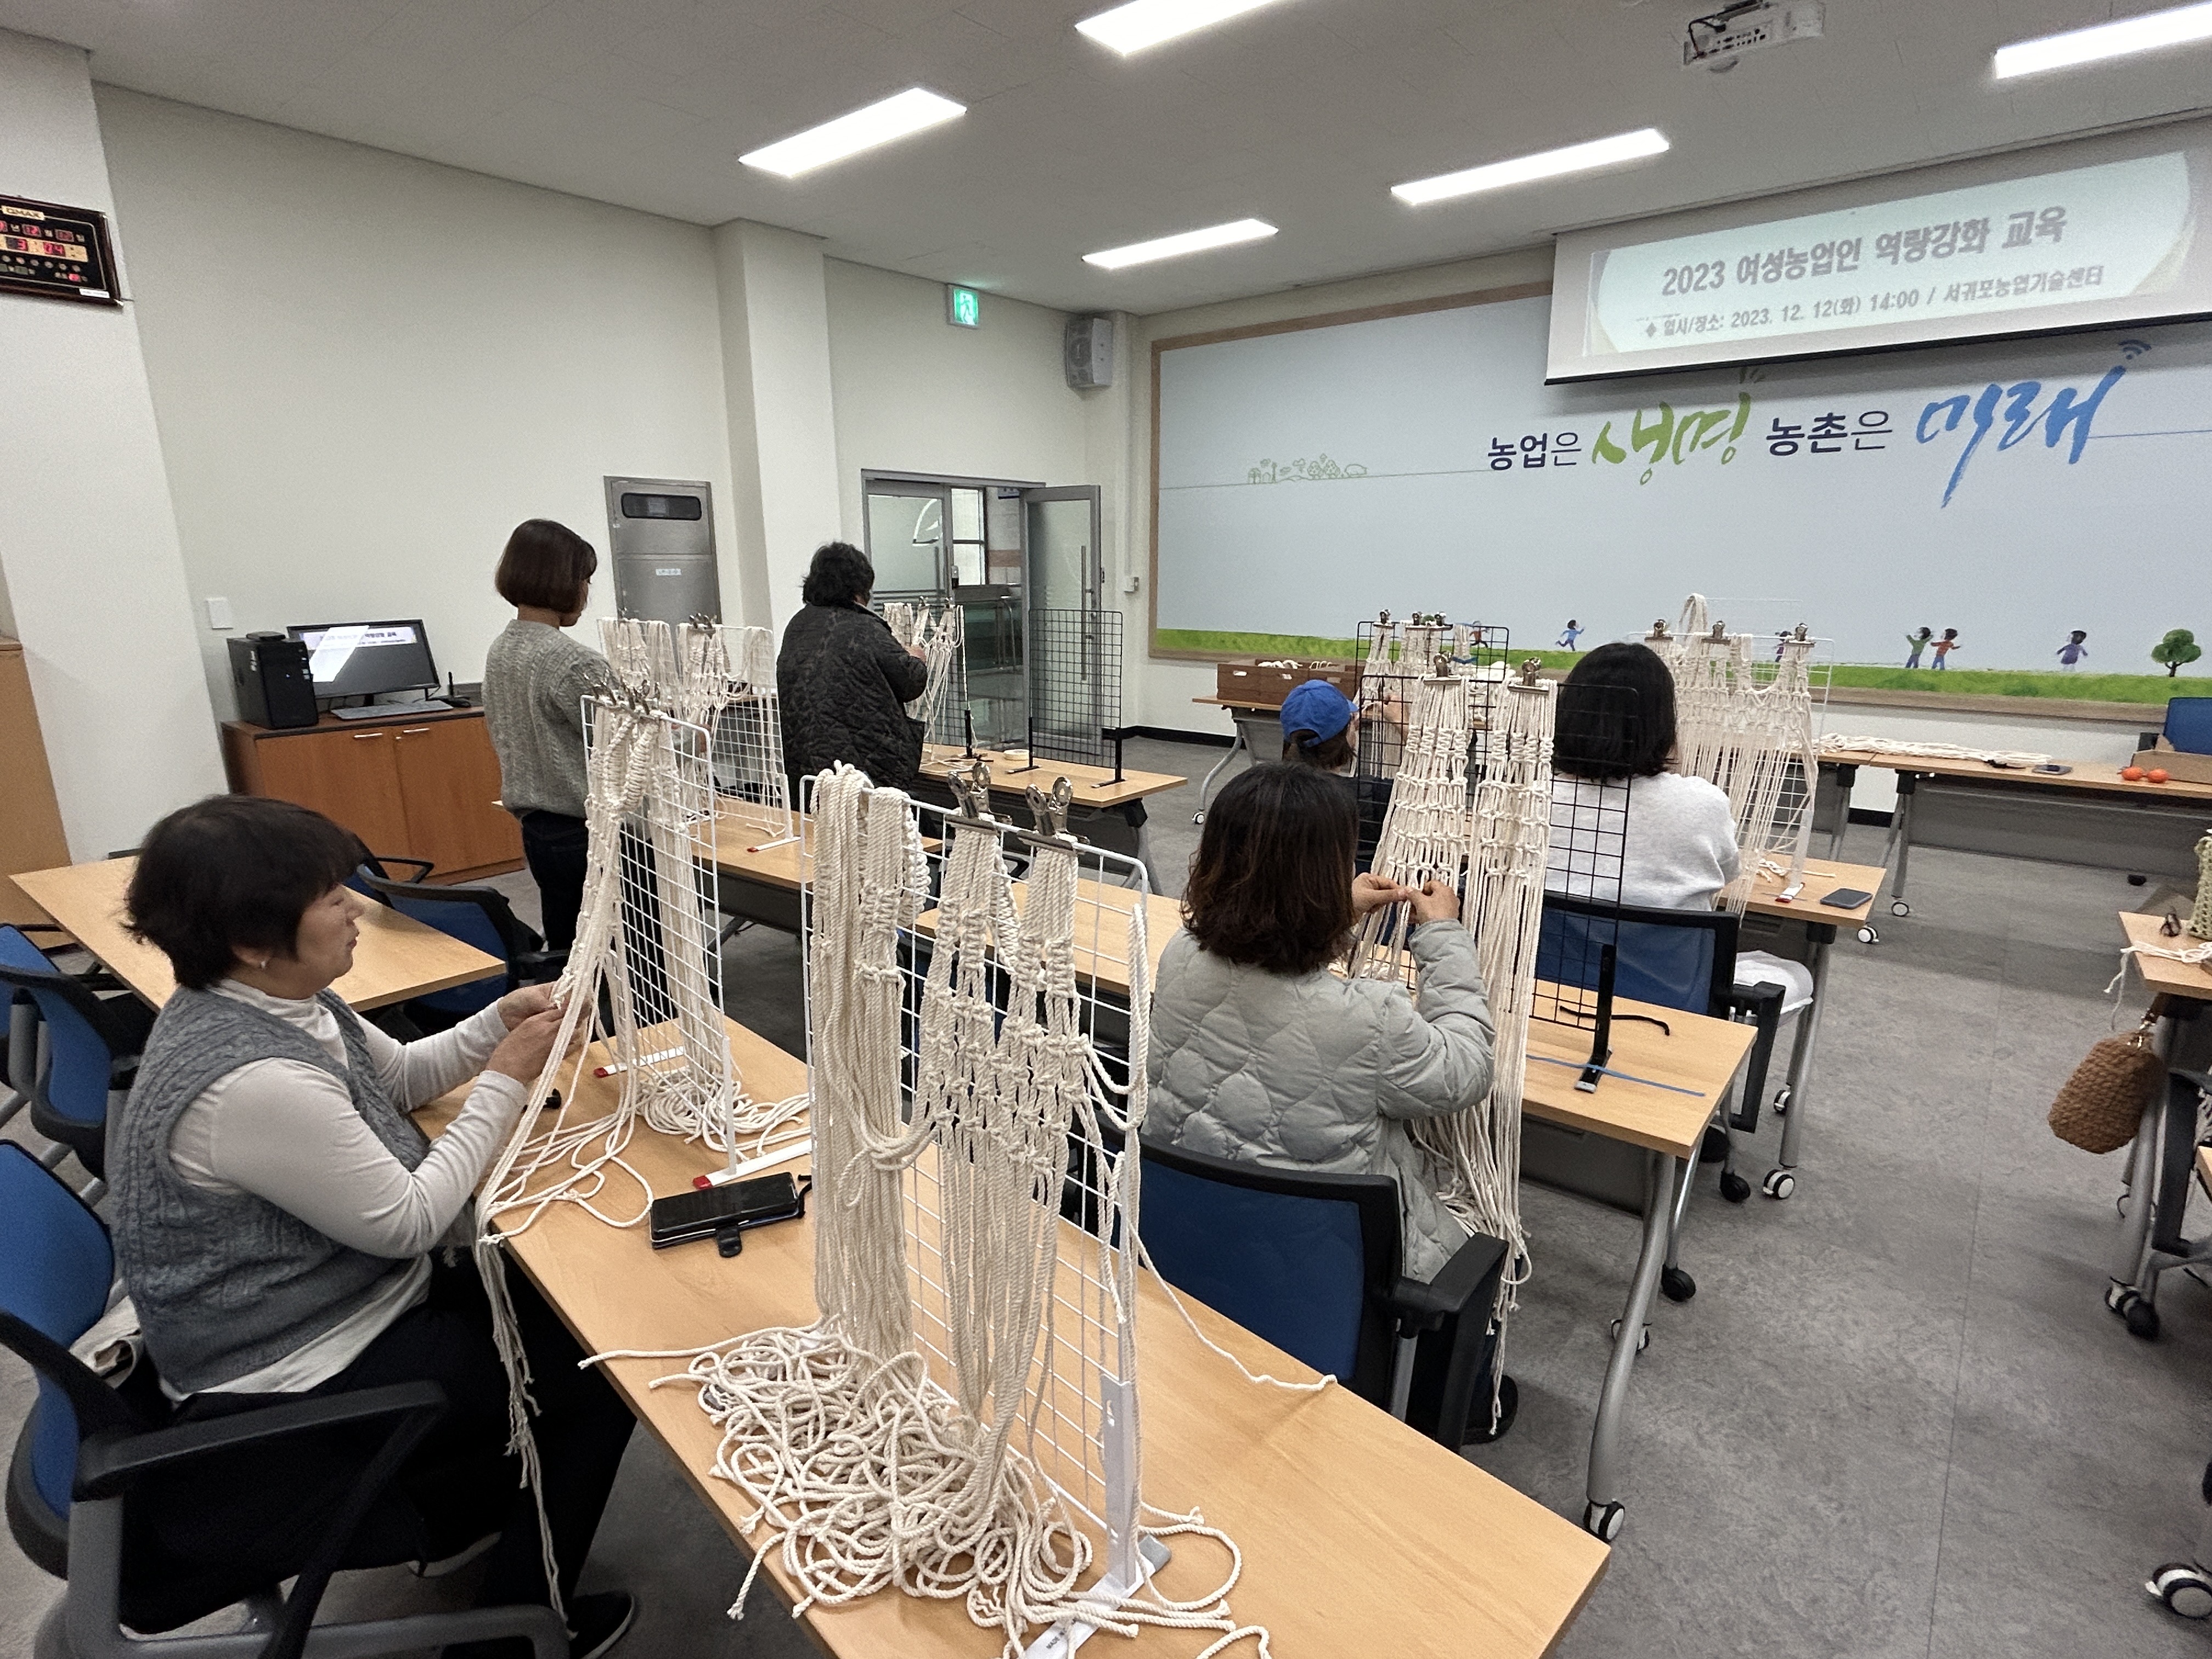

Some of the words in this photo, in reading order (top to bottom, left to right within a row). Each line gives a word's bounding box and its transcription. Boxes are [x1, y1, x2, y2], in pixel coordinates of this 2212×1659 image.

[1662, 261, 1725, 296] 2023
[1737, 238, 1862, 285] 여성농업인
[1875, 217, 1990, 264] 역량강화
[2001, 206, 2067, 249] 교육
[1664, 314, 1724, 336] 일시/장소:
[1731, 308, 1772, 328] 2023.
[1781, 303, 1804, 322] 12.
[1813, 296, 1861, 318] 12(화)
[1870, 289, 1919, 311] 14:00
[1926, 287, 1936, 304] /
[1944, 266, 2104, 303] 서귀포농업기술센터
[1488, 432, 1582, 471] 농업은
[1592, 392, 1751, 485] 생명
[1766, 410, 1892, 456] 농촌은
[1916, 365, 2126, 508] 미래
